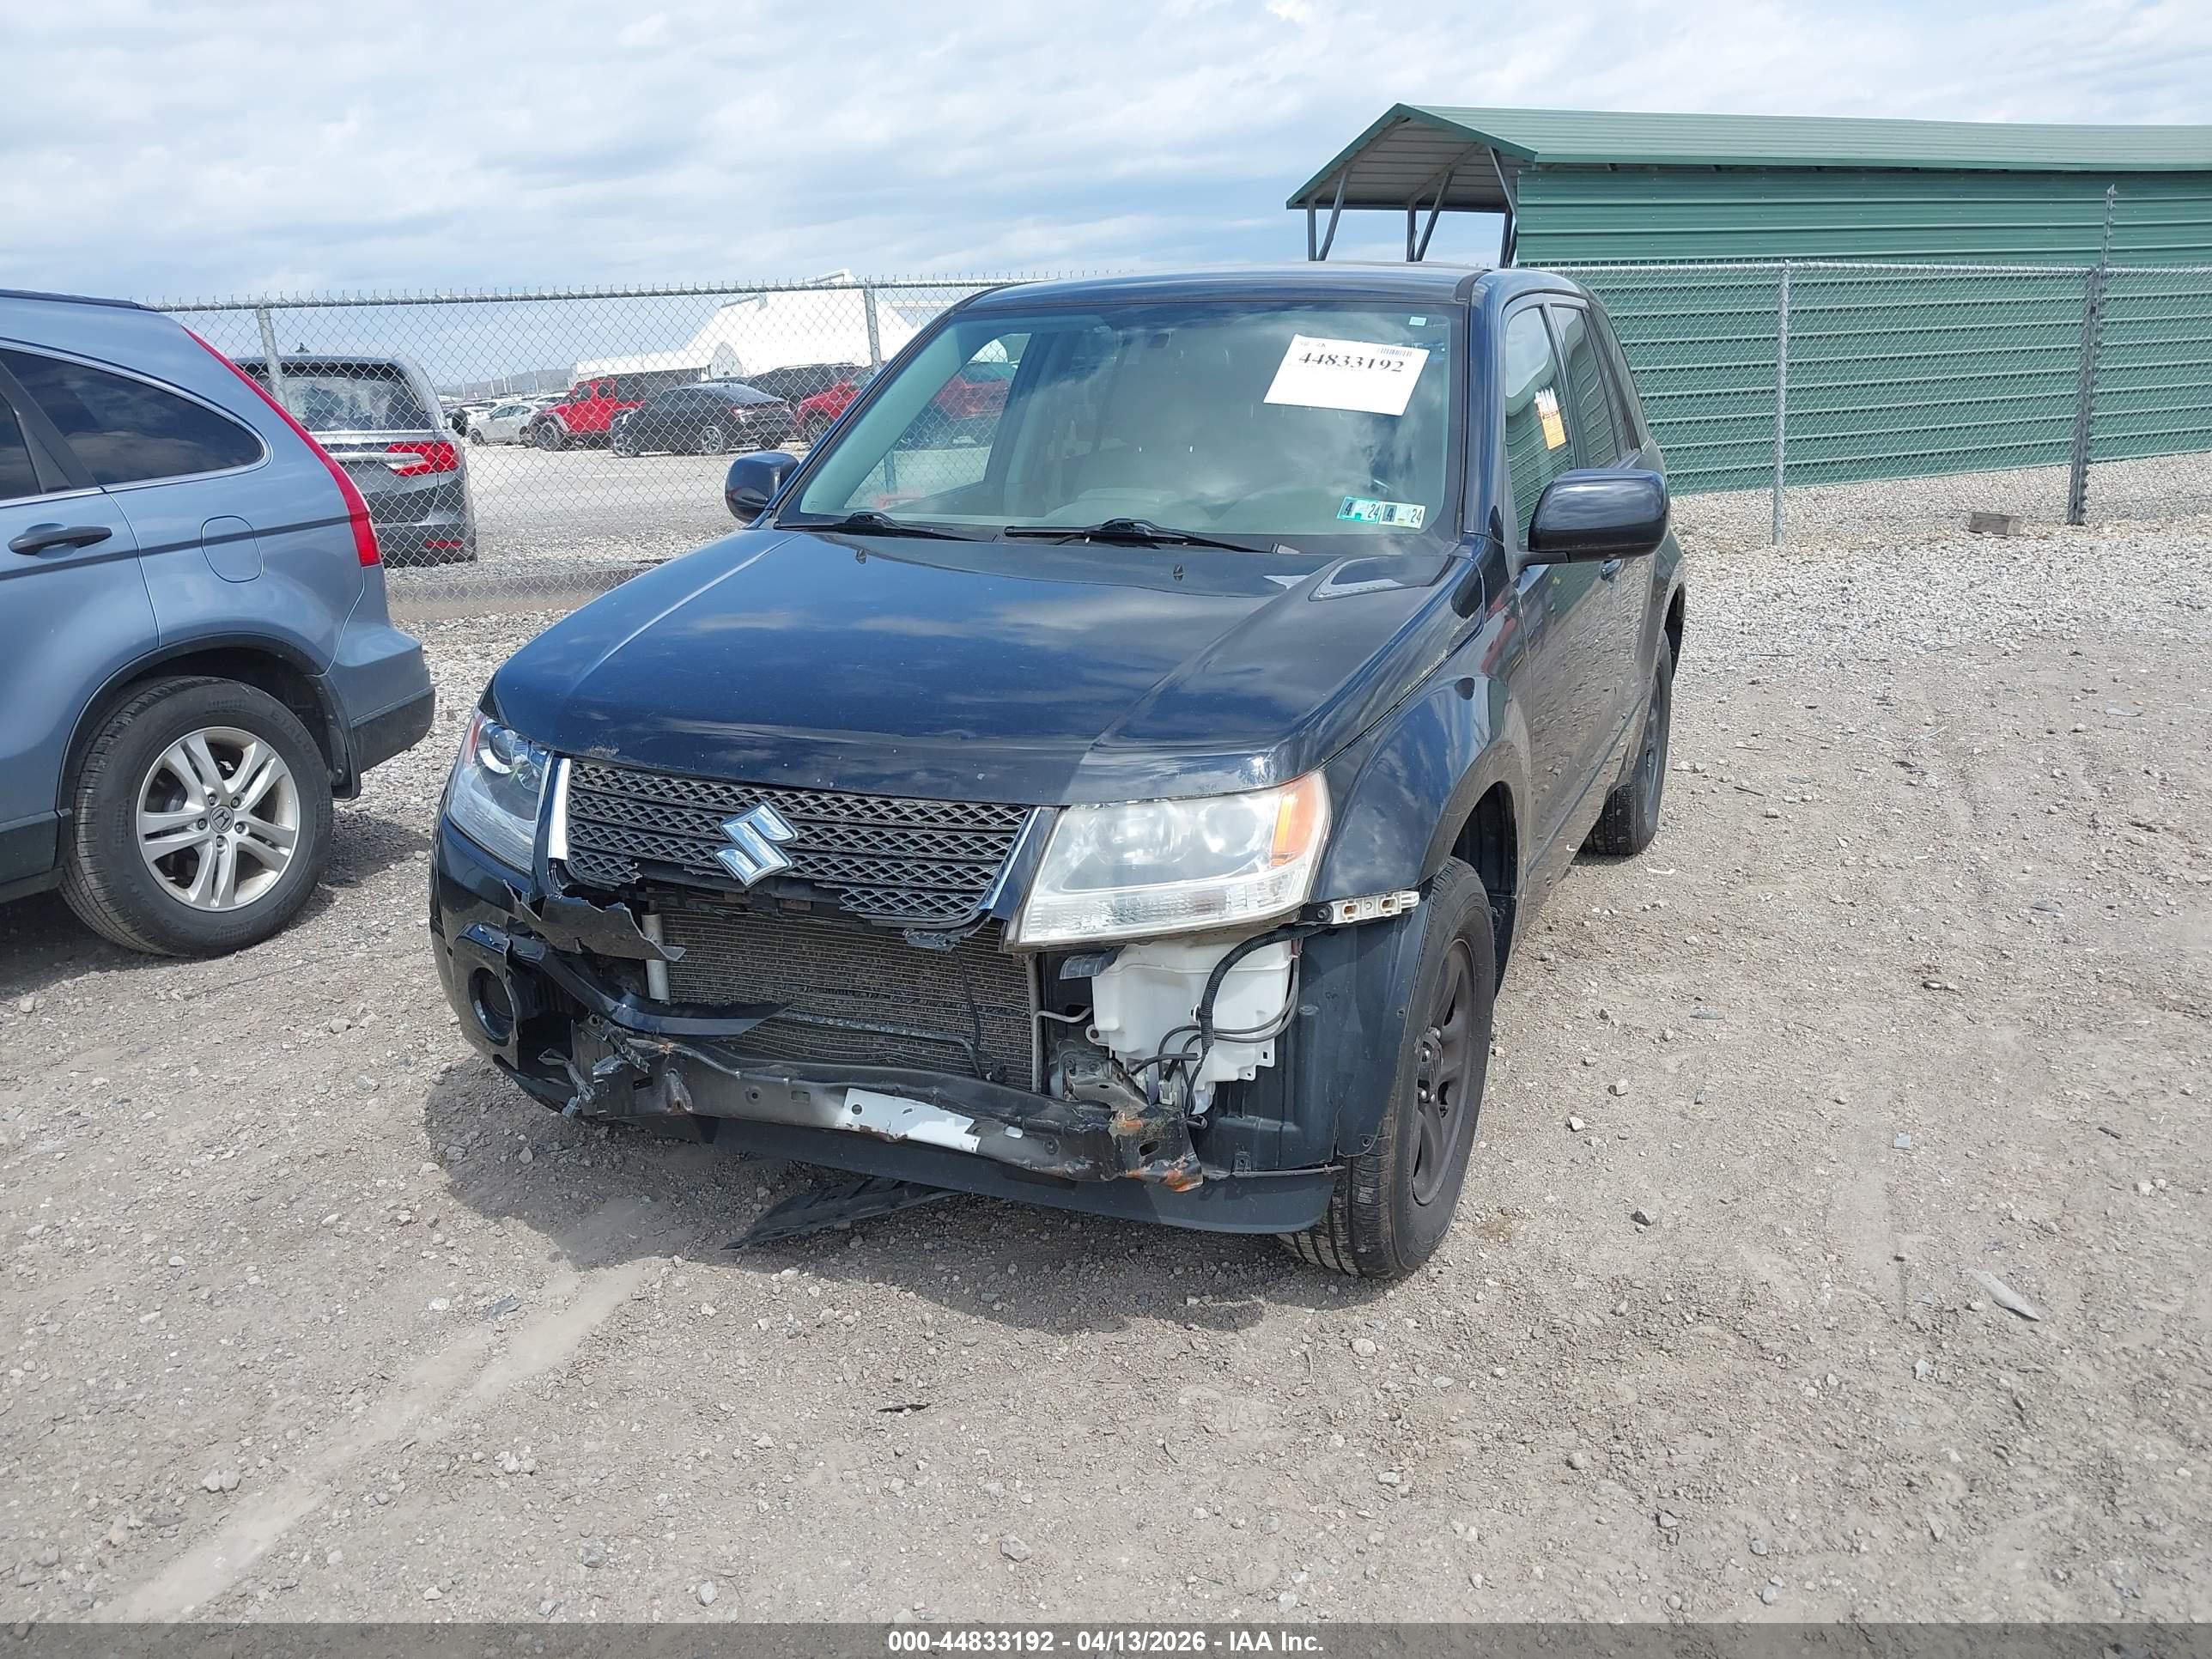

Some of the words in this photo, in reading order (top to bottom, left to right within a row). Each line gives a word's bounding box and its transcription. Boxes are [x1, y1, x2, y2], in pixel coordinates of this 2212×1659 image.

[1298, 352, 1405, 373] 44833192
[1367, 503, 1381, 520] 24
[1410, 508, 1423, 524] 24
